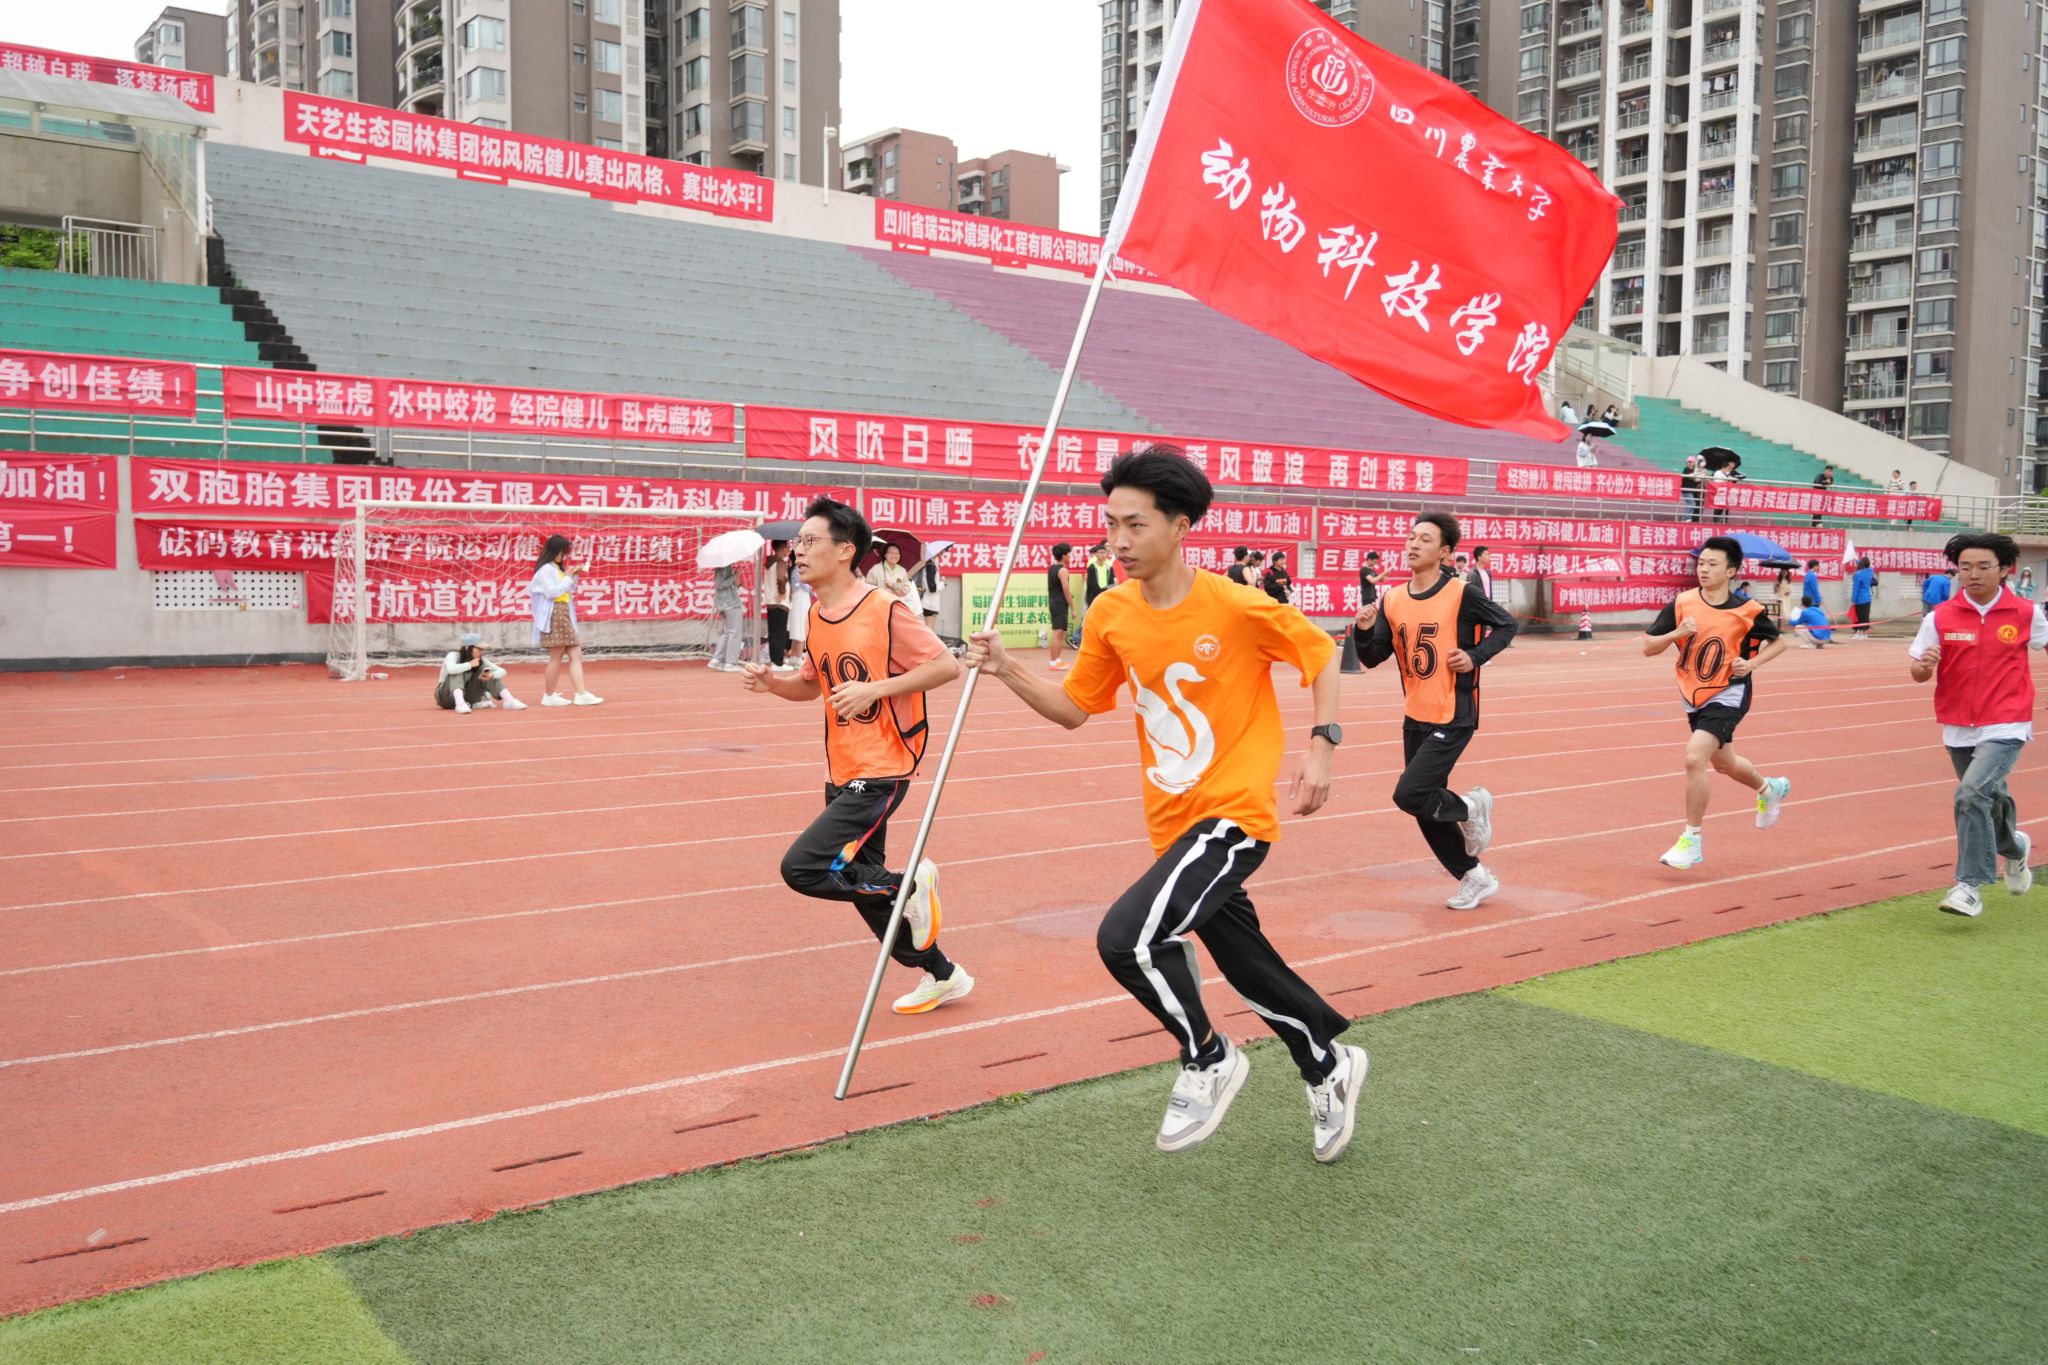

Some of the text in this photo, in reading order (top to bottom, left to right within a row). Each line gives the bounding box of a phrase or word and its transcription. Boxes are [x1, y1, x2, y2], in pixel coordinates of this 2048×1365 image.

[1292, 86, 1337, 123] AGRICULTURAL
[1339, 85, 1369, 121] UNIVERSITY
[255, 376, 713, 437] 山中猛虎 水中蛟龙 经院健儿 卧虎藏龙
[0, 460, 105, 500] 加油！
[809, 417, 974, 467] 风吹日晒
[1328, 454, 1435, 493] 再创辉煌
[1398, 622, 1439, 680] 15
[1676, 632, 1726, 682] 10
